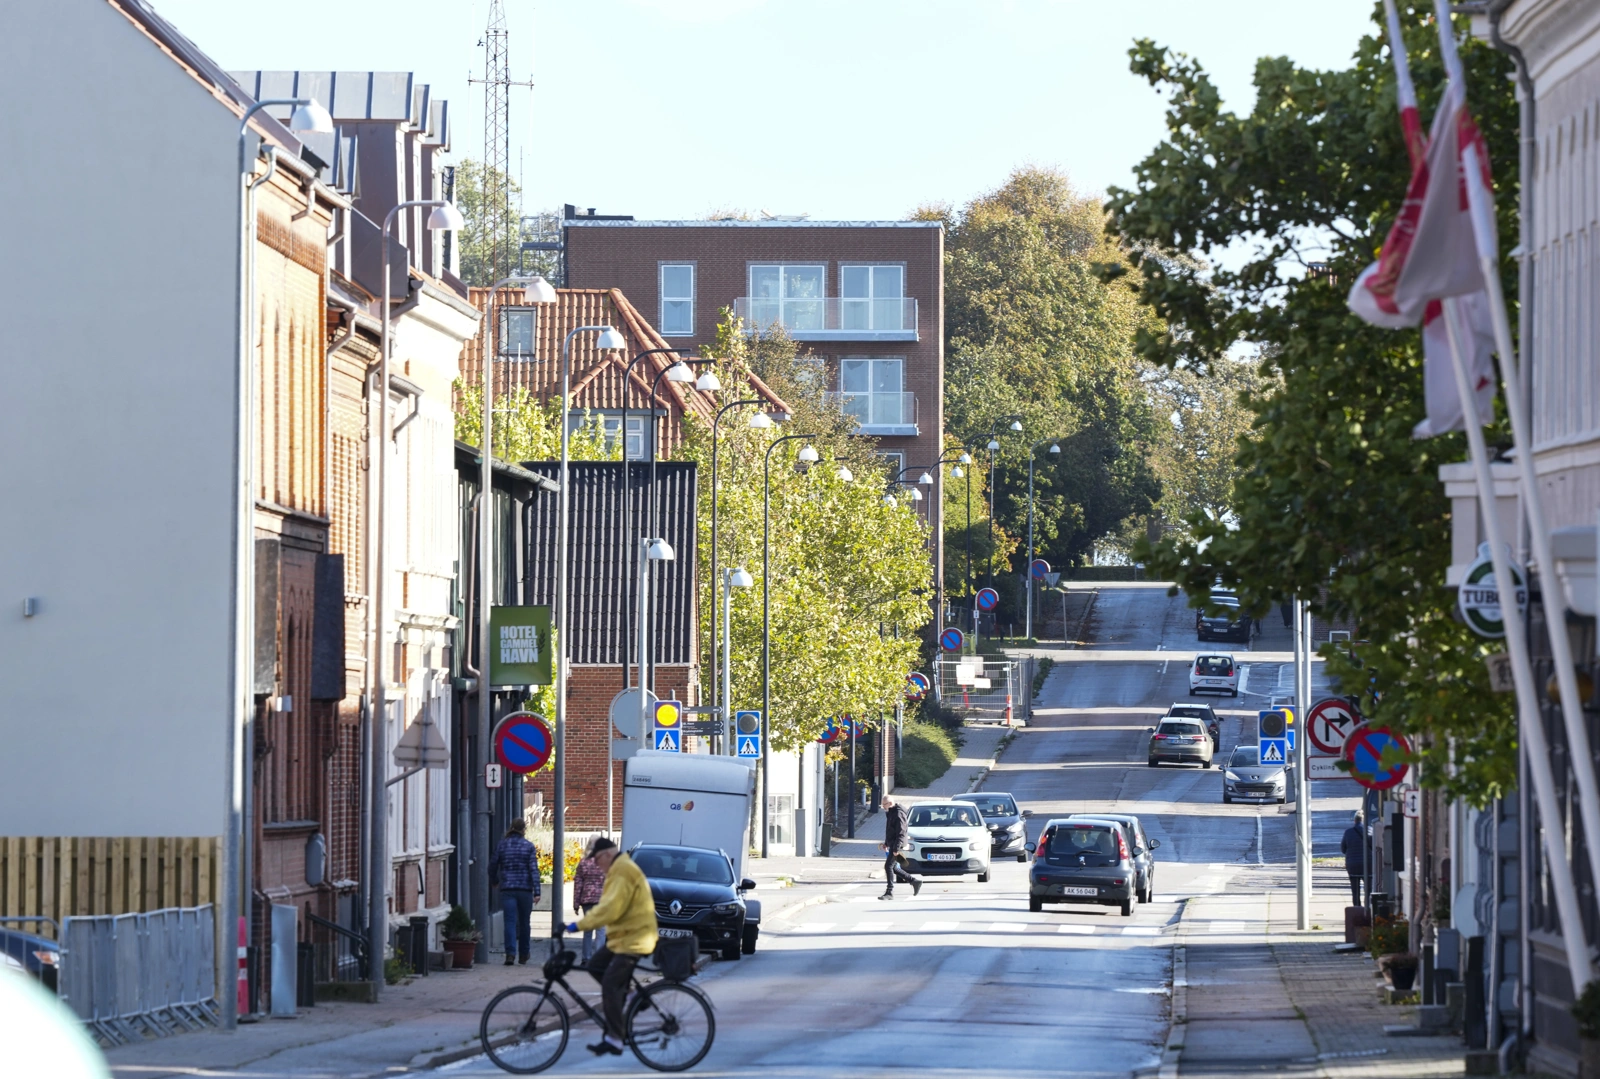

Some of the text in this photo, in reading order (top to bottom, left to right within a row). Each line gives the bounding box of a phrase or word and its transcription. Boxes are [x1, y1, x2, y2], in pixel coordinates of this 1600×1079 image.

[1462, 590, 1525, 605] TUBG
[500, 625, 538, 639] HOTEL
[500, 639, 538, 648] GAMMEL
[500, 648, 539, 663] HAVN
[670, 803, 682, 811] Q8
[658, 929, 668, 937] CZ
[669, 930, 678, 938] 78
